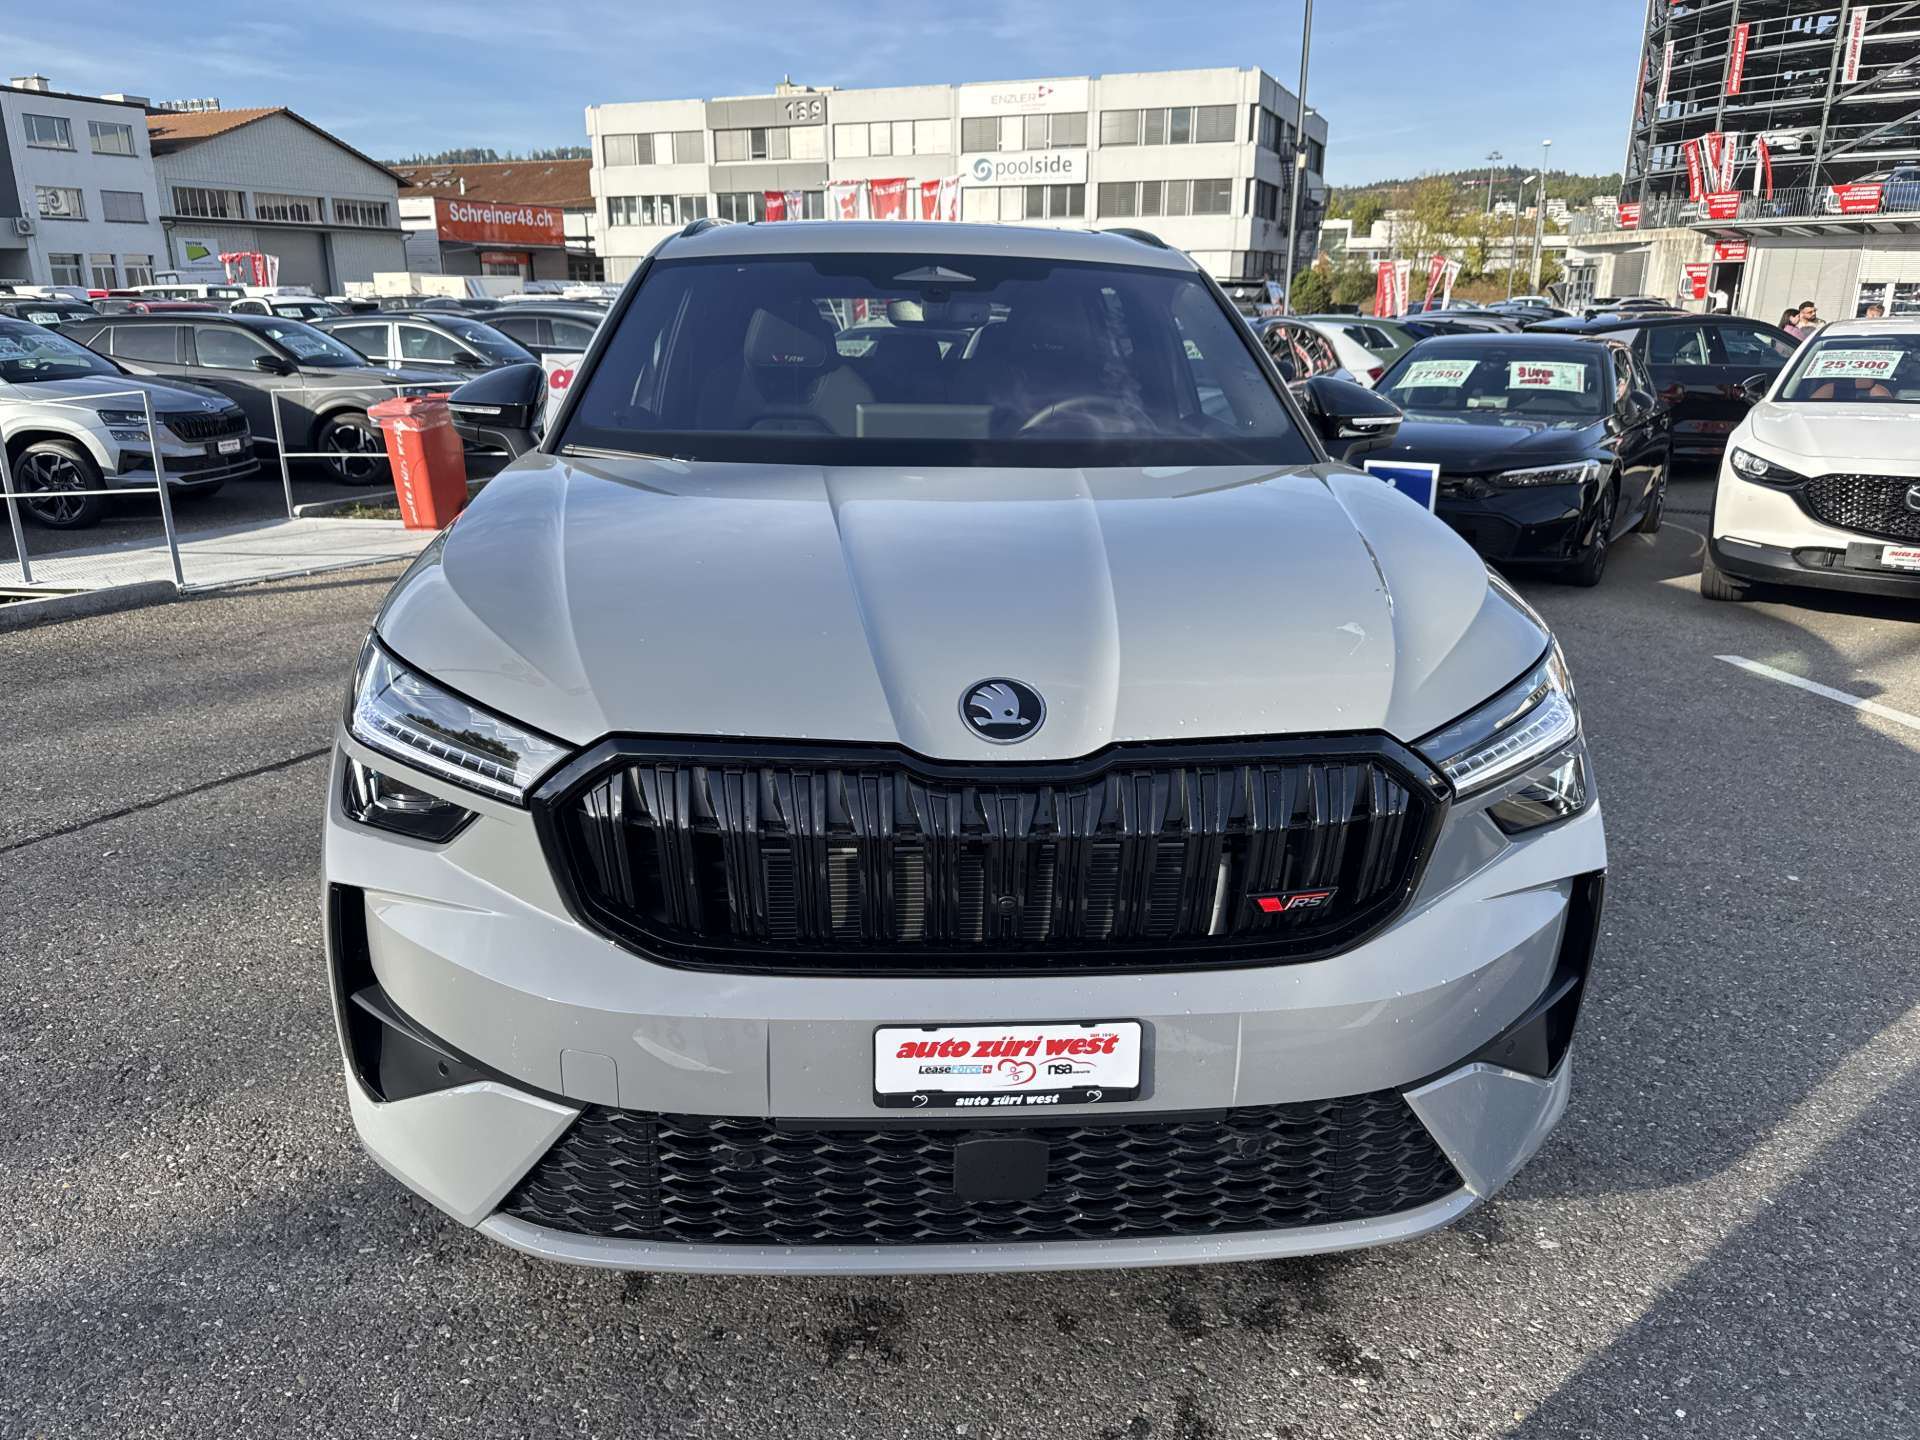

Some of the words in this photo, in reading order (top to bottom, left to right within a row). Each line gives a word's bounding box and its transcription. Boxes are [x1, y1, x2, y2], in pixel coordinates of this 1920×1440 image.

[991, 93, 1037, 105] ENZLER
[996, 155, 1072, 181] poolside
[449, 202, 553, 227] Schreiner48.ch
[1822, 360, 1889, 370] 25'300
[896, 1037, 971, 1058] auto
[971, 1035, 1043, 1057] züri
[1046, 1034, 1120, 1056] west
[918, 1065, 982, 1074] LeaseForce
[1048, 1064, 1072, 1075] nsa
[955, 1096, 989, 1106] auto
[991, 1094, 1023, 1106] züri
[1026, 1094, 1059, 1104] west
